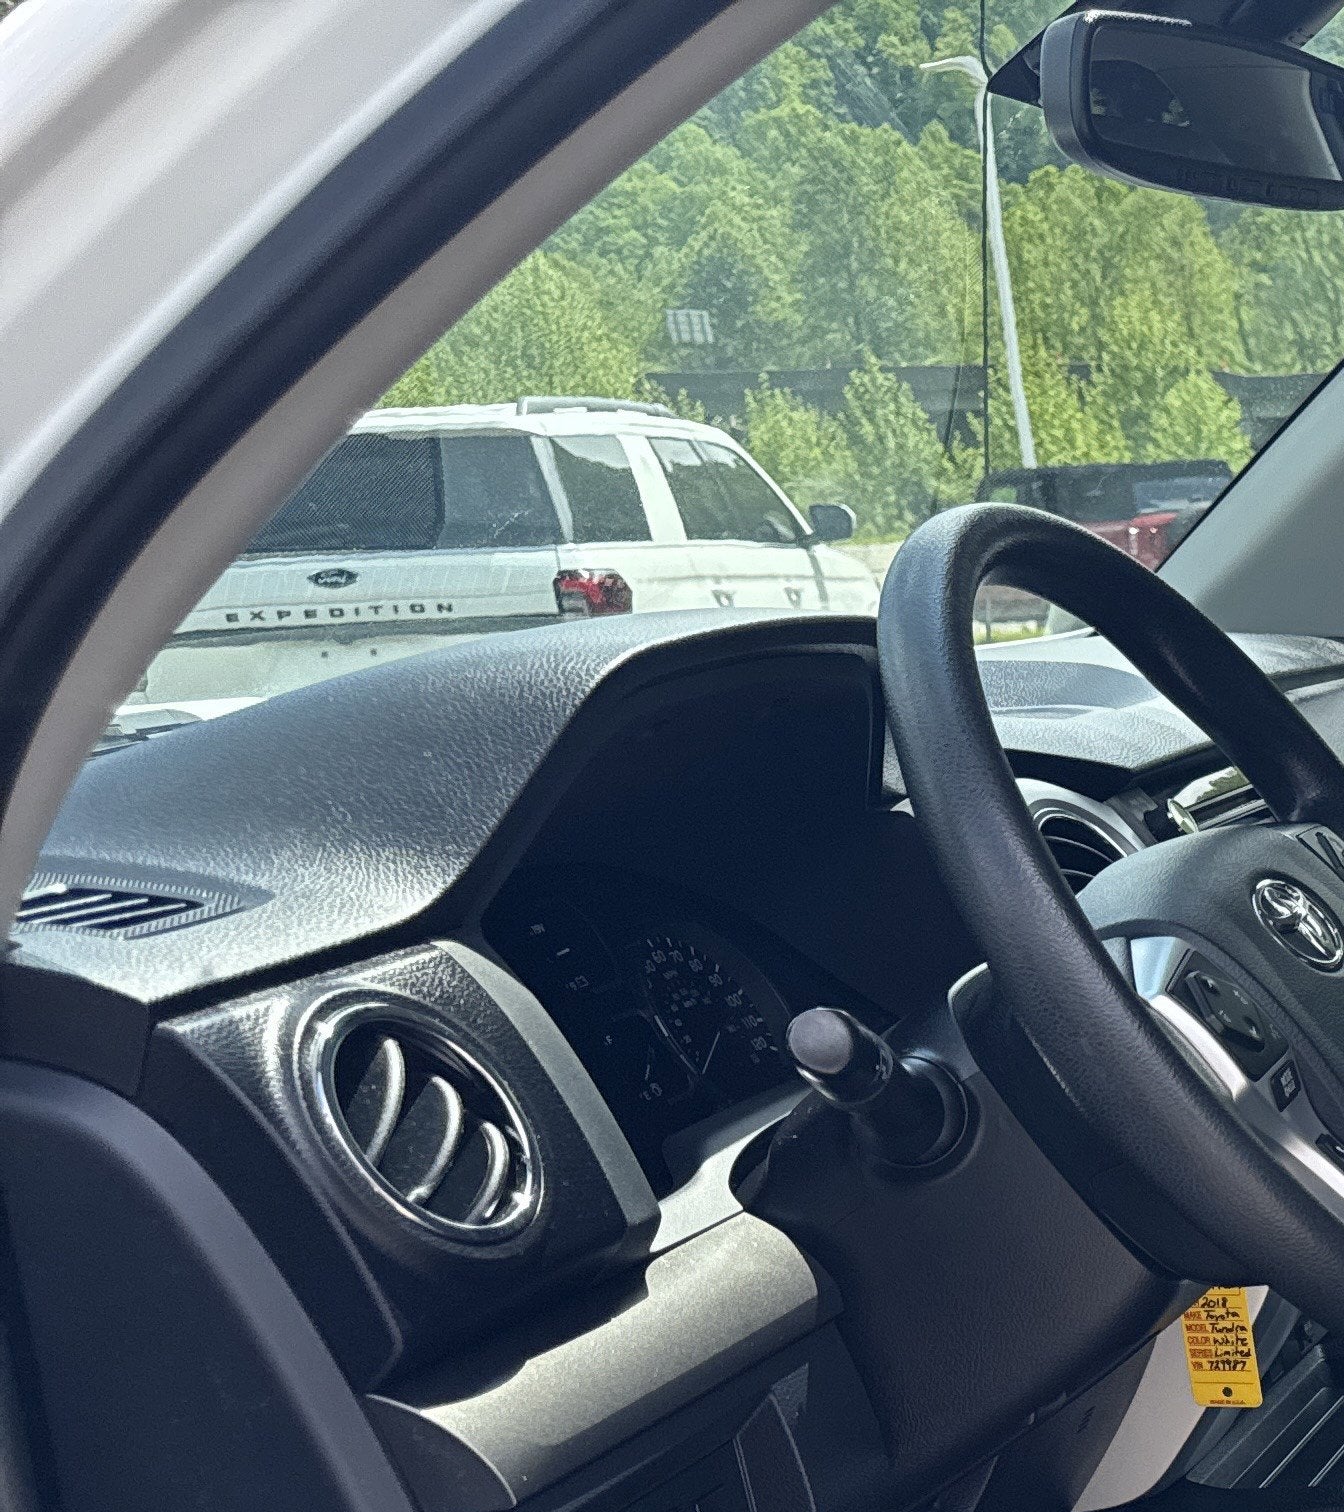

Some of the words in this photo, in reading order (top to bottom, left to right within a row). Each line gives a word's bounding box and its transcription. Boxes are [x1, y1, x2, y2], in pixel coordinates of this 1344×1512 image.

[225, 602, 454, 623] EXPEDITION
[1200, 1296, 1229, 1308] 2018
[1204, 1307, 1240, 1322] Toyota
[1185, 1323, 1208, 1333] MODEL
[1209, 1322, 1248, 1334] Tundra
[1187, 1336, 1211, 1346] COLOR
